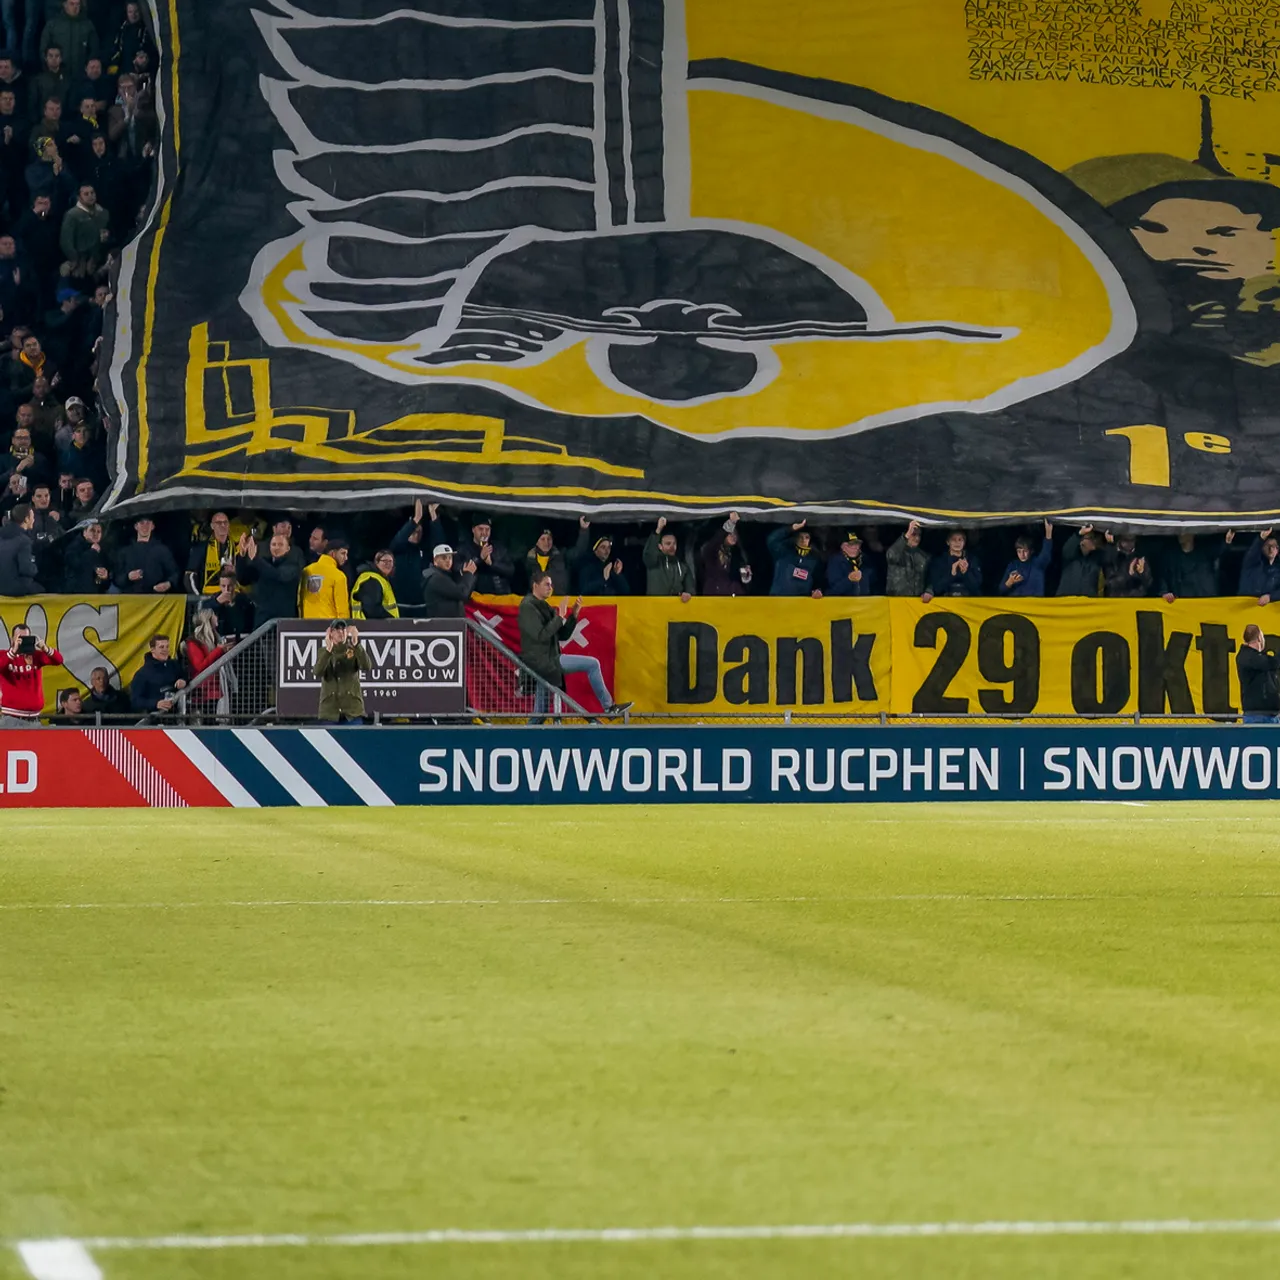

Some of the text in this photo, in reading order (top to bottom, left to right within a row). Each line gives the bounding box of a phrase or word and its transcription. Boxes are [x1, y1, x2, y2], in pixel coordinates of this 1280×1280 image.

[969, 70, 1069, 83] STANISŁAW
[1078, 70, 1175, 90] WŁADYSŁAW
[287, 639, 456, 667] MVIRO
[666, 618, 880, 706] Dank
[913, 611, 1041, 716] 29
[419, 747, 753, 792] SNOWWORLD
[771, 747, 999, 791] RUCPHEN
